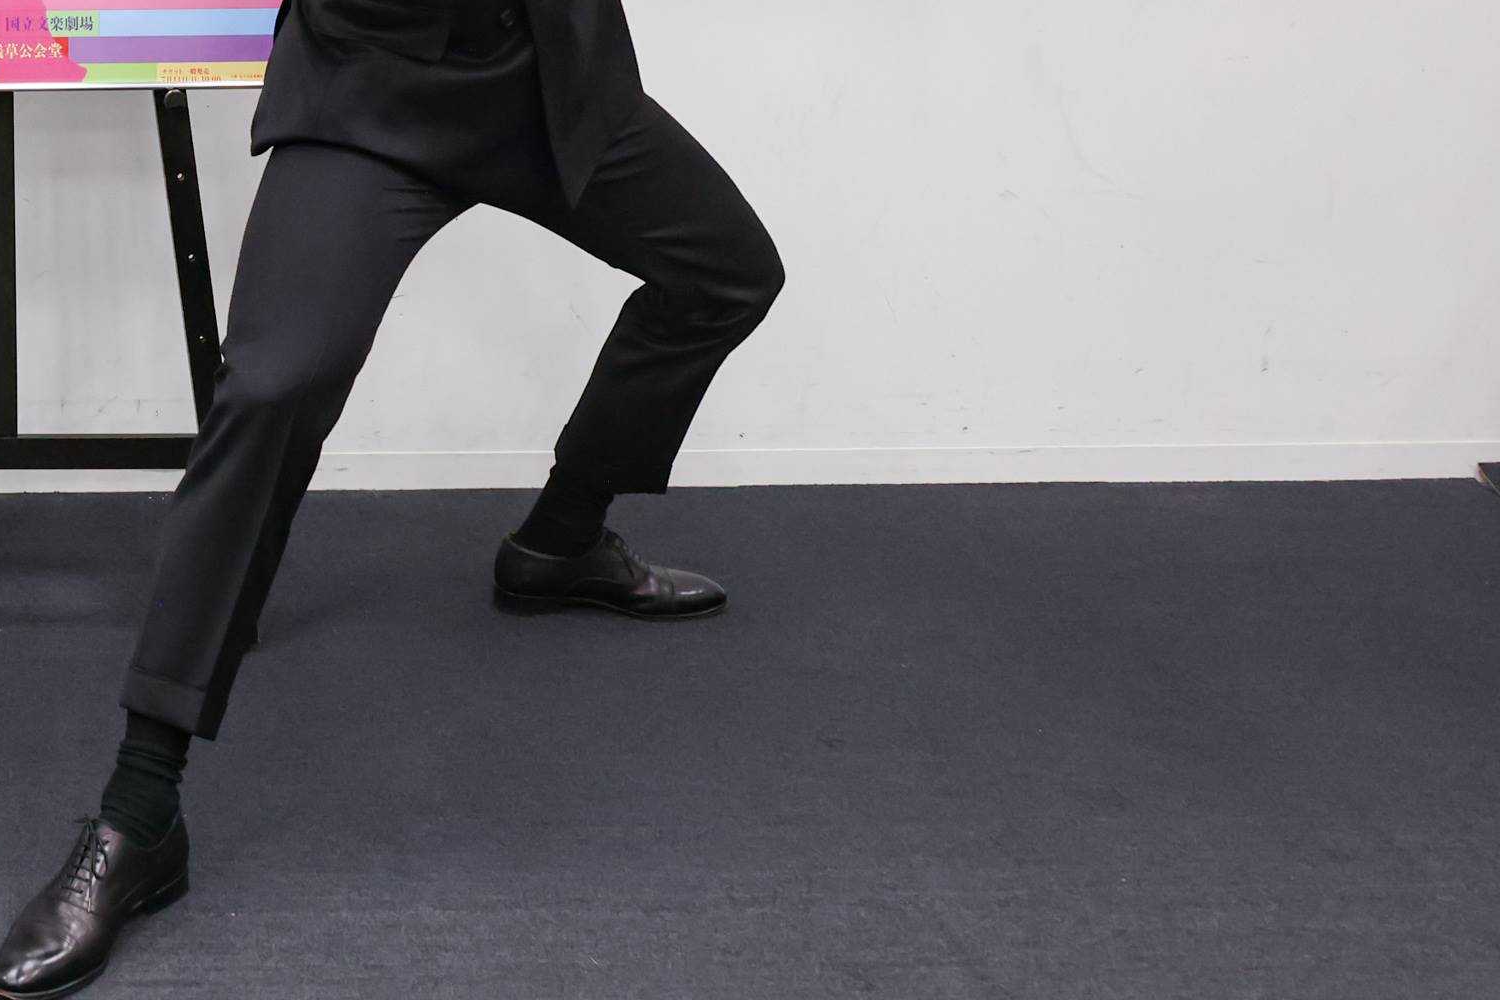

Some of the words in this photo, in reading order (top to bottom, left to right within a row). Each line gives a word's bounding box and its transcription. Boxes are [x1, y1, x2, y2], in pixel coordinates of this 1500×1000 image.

[5, 16, 94, 32] 国立文楽劇場
